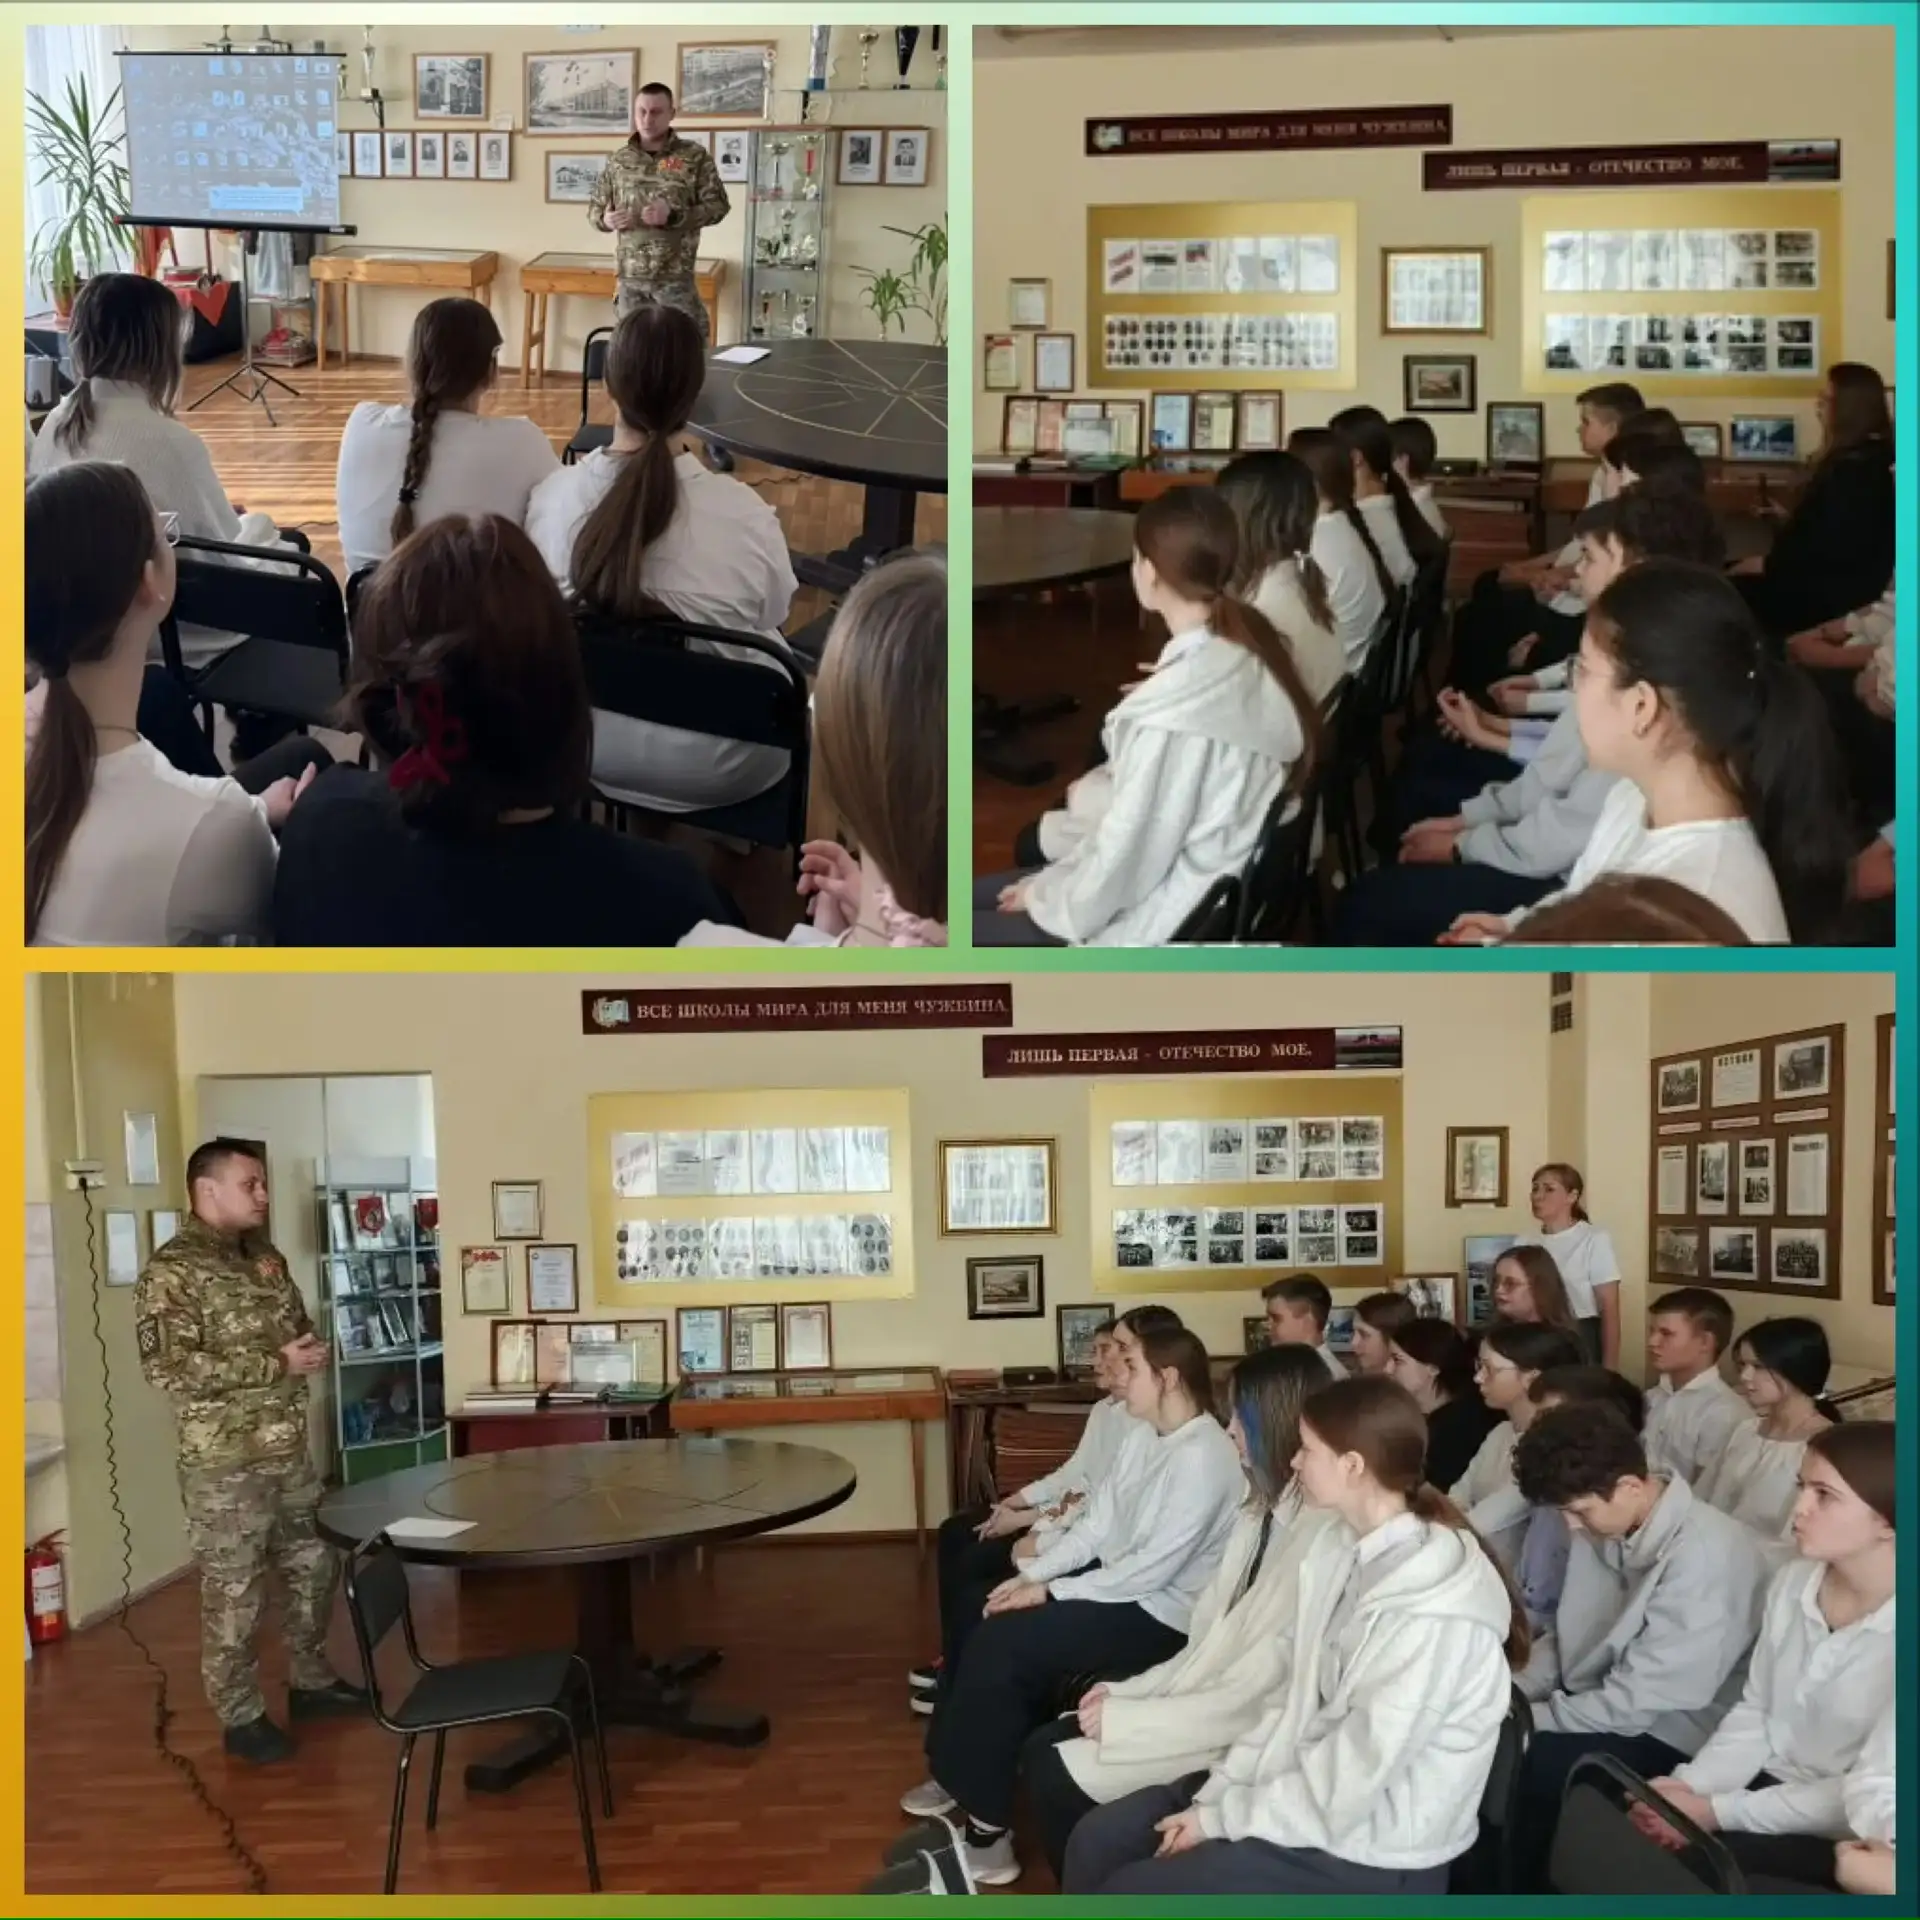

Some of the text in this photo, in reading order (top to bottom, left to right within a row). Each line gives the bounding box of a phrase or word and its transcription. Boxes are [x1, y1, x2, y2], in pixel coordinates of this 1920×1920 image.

[636, 1003, 673, 1019] ВСЕ
[678, 1003, 750, 1018] ШКОЛЫ
[757, 1002, 808, 1017] МИРА
[814, 1001, 850, 1018] ДЛЯ
[857, 1000, 908, 1014] МЕНЯ
[1006, 1049, 1063, 1063] ЛИШЬ
[1068, 1047, 1139, 1062] ПЕРВАЯ
[1159, 1043, 1261, 1060] ОТЕЧЕСТВО
